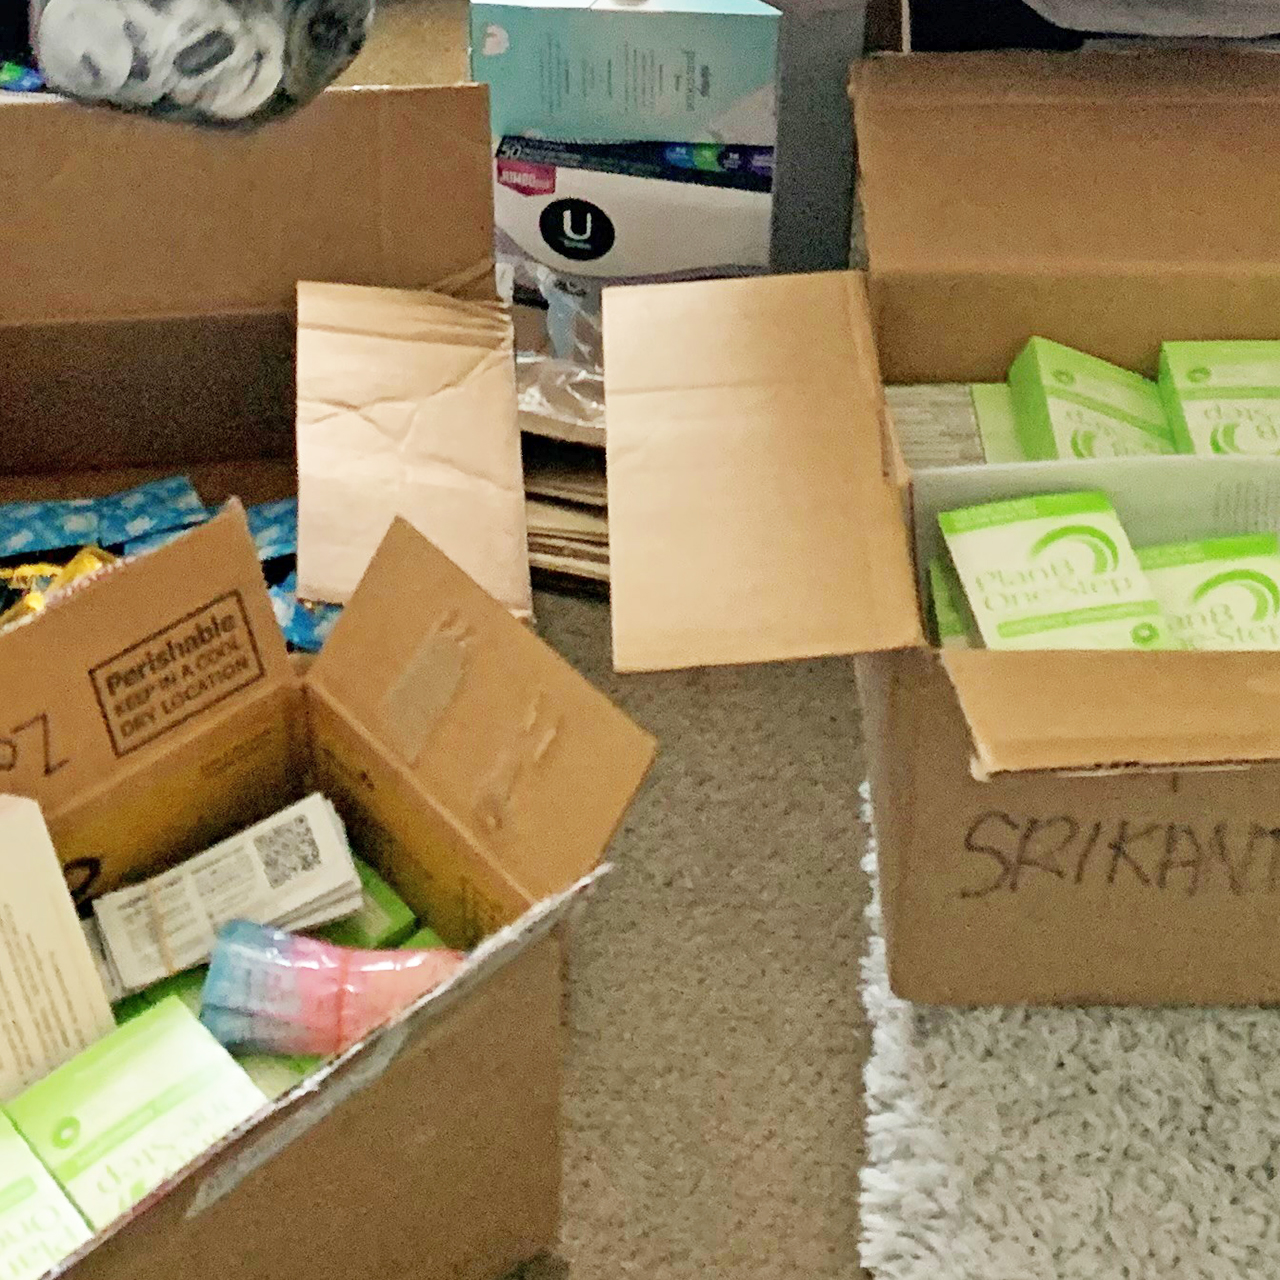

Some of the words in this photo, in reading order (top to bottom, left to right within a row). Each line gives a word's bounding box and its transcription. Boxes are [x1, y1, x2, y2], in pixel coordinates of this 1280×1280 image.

[562, 209, 593, 241] U
[106, 614, 236, 696] Perishable
[120, 706, 156, 738] DRY
[160, 654, 250, 715] LOCATION
